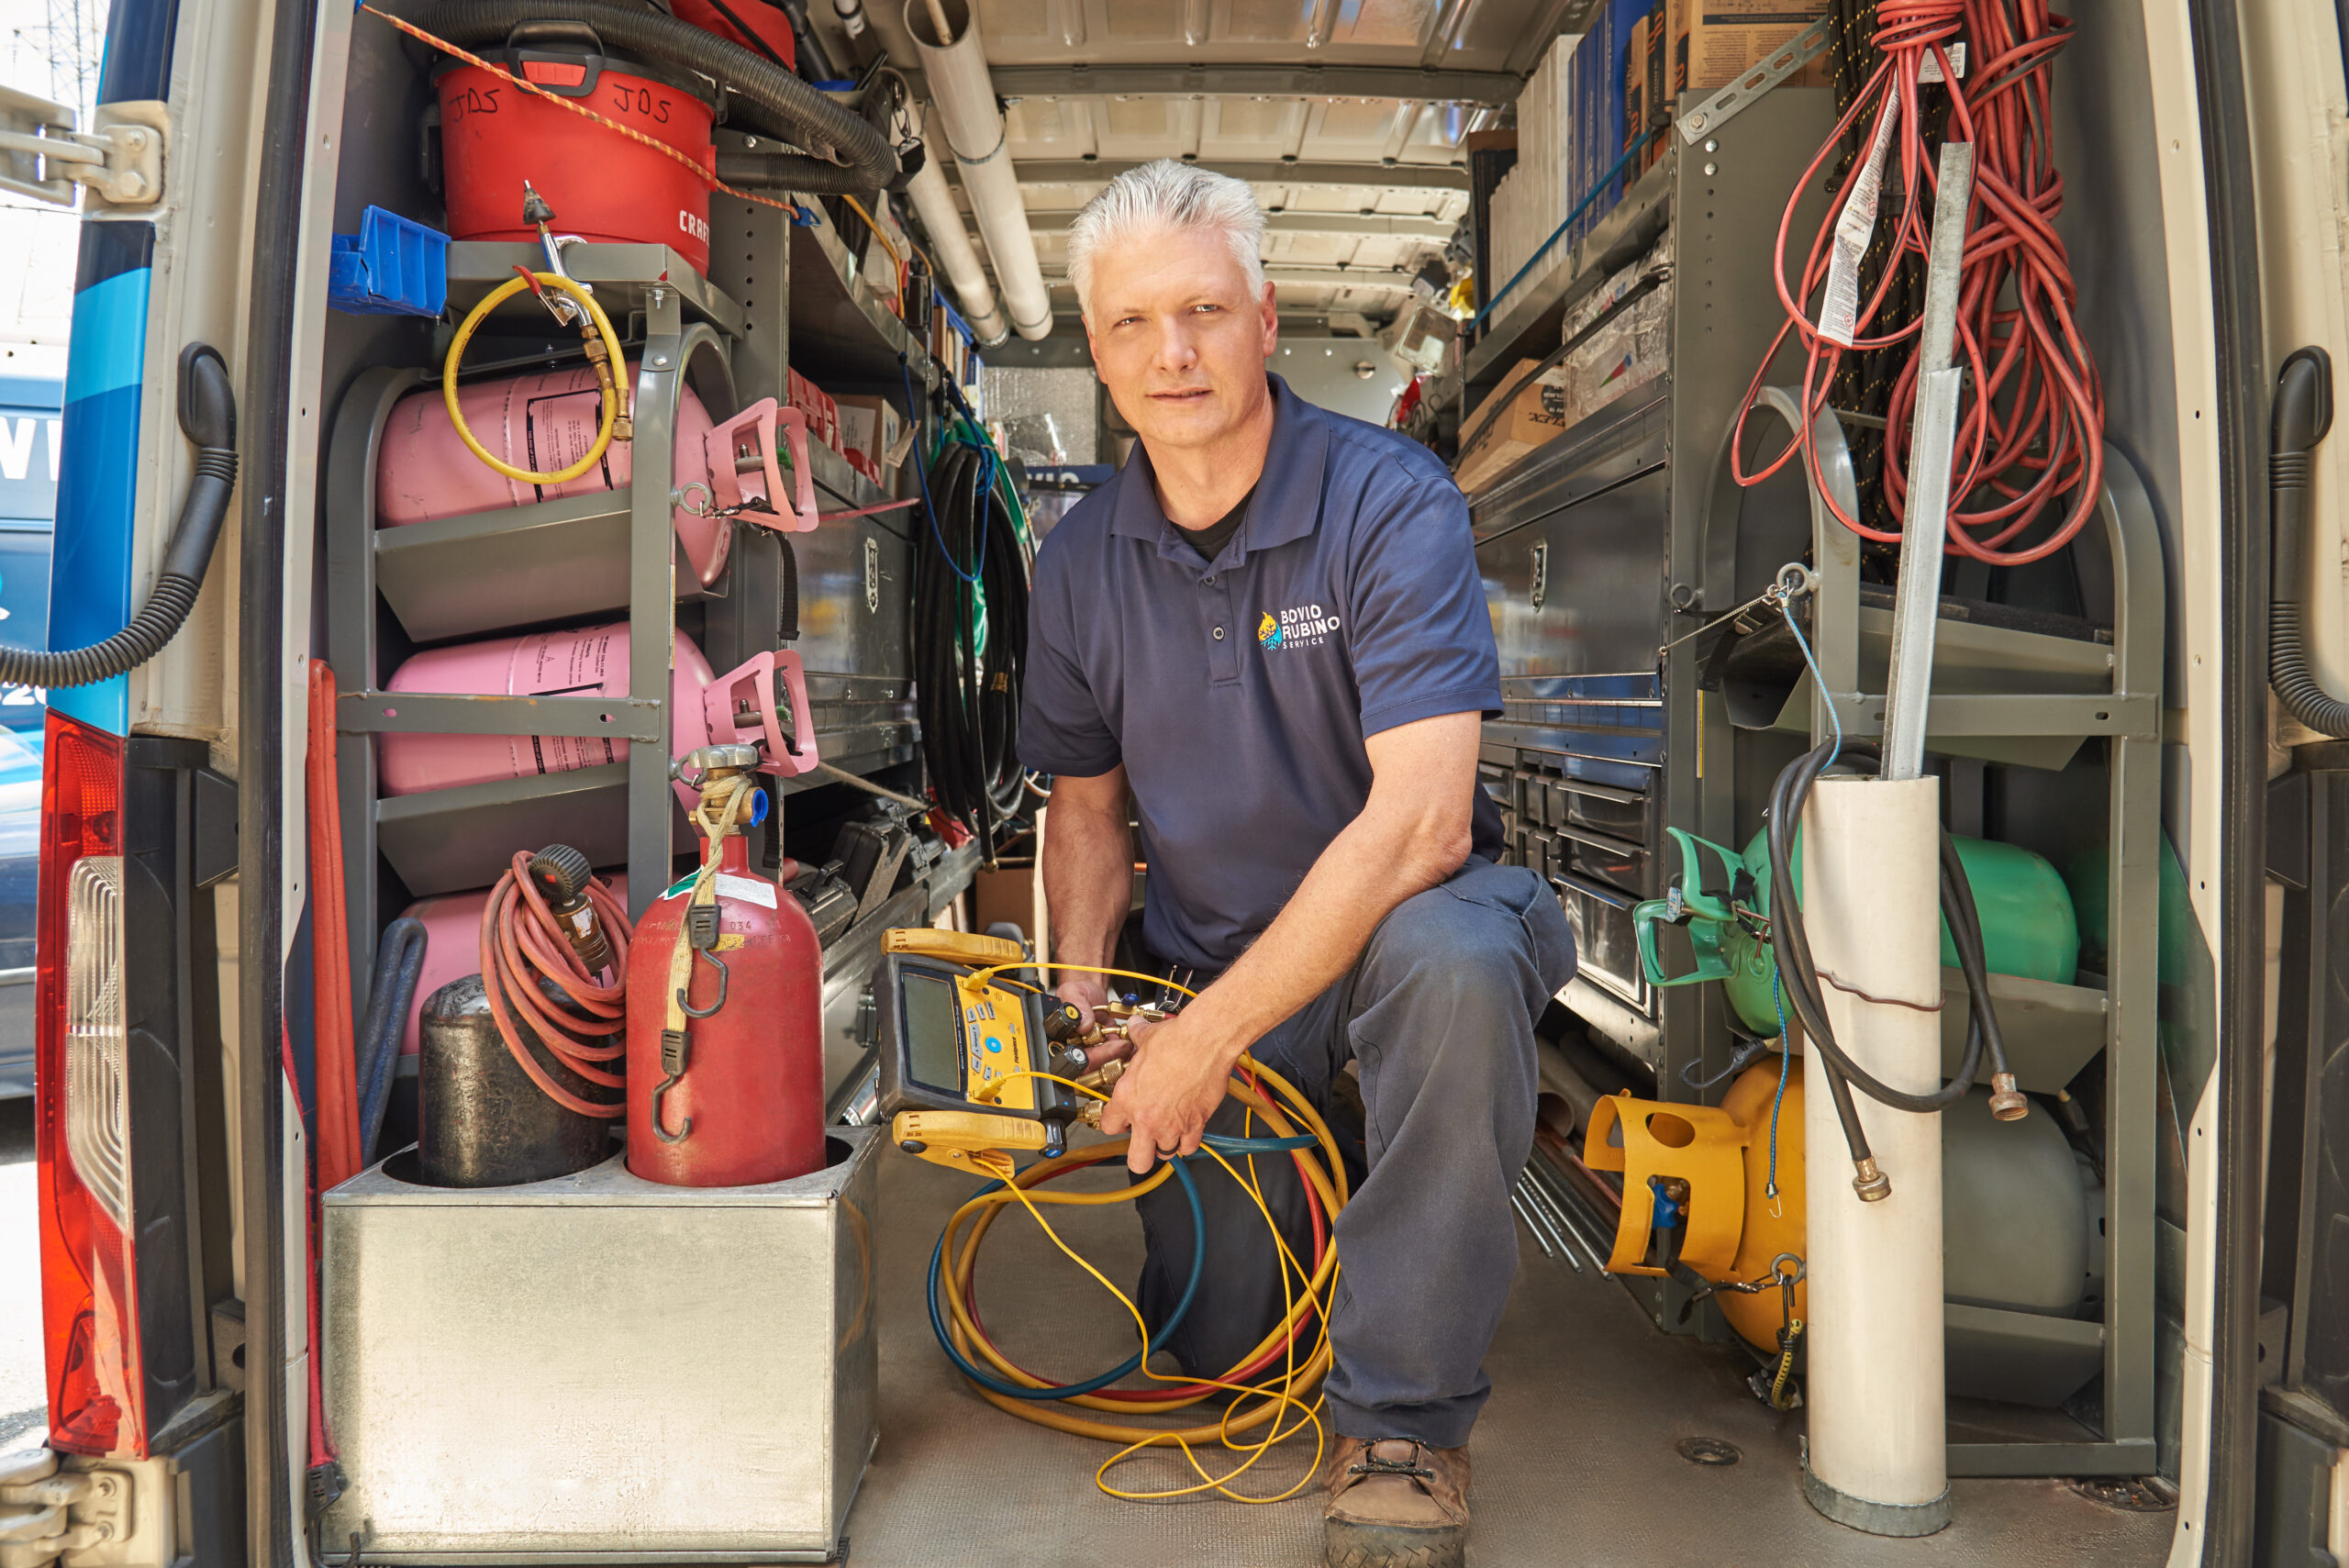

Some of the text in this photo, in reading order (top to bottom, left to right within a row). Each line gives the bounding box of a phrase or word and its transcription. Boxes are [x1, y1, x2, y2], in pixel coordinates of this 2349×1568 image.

[450, 87, 500, 122] JDS
[1281, 605, 1321, 624] BOVIO
[1282, 617, 1340, 639] RUBINO
[1283, 637, 1324, 650] SERVICE
